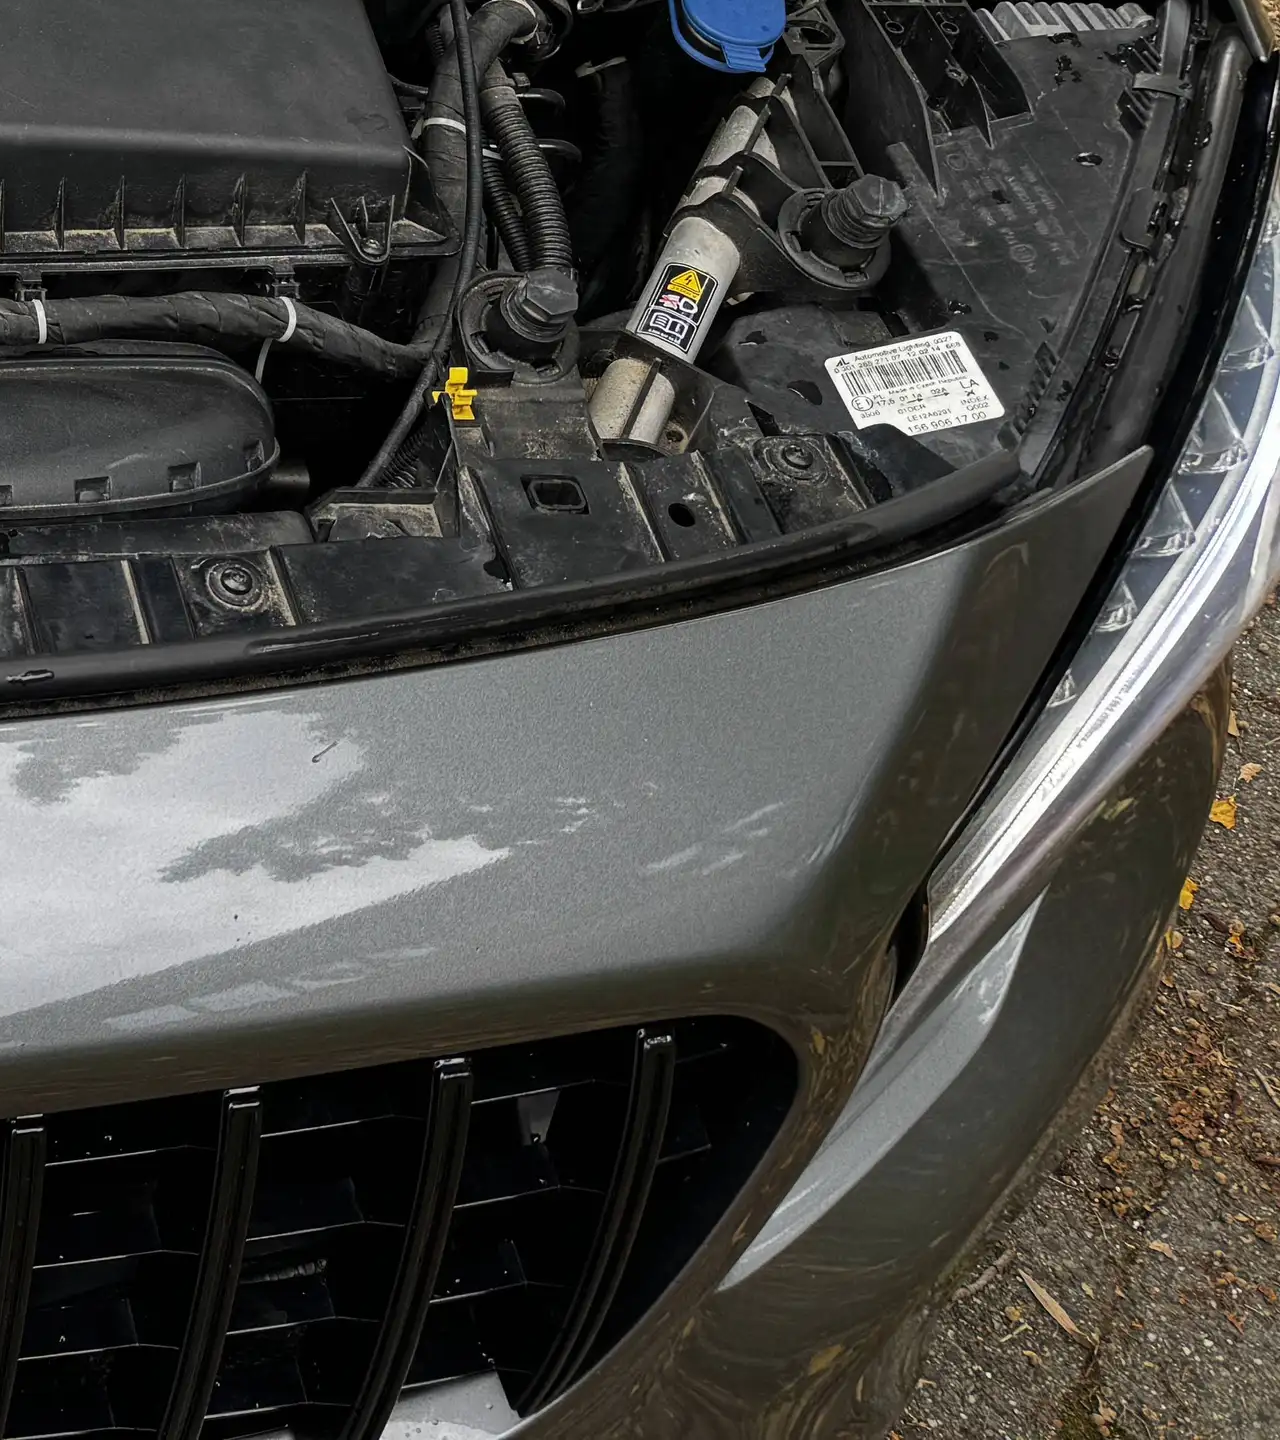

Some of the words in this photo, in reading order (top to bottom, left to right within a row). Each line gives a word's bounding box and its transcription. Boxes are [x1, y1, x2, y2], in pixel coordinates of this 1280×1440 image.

[852, 347, 898, 362] Automotive
[897, 340, 931, 352] Lighting
[958, 377, 979, 389] LA
[907, 423, 929, 433] 156
[930, 417, 953, 428] 906
[955, 414, 969, 423] 17
[970, 411, 987, 420] 00
